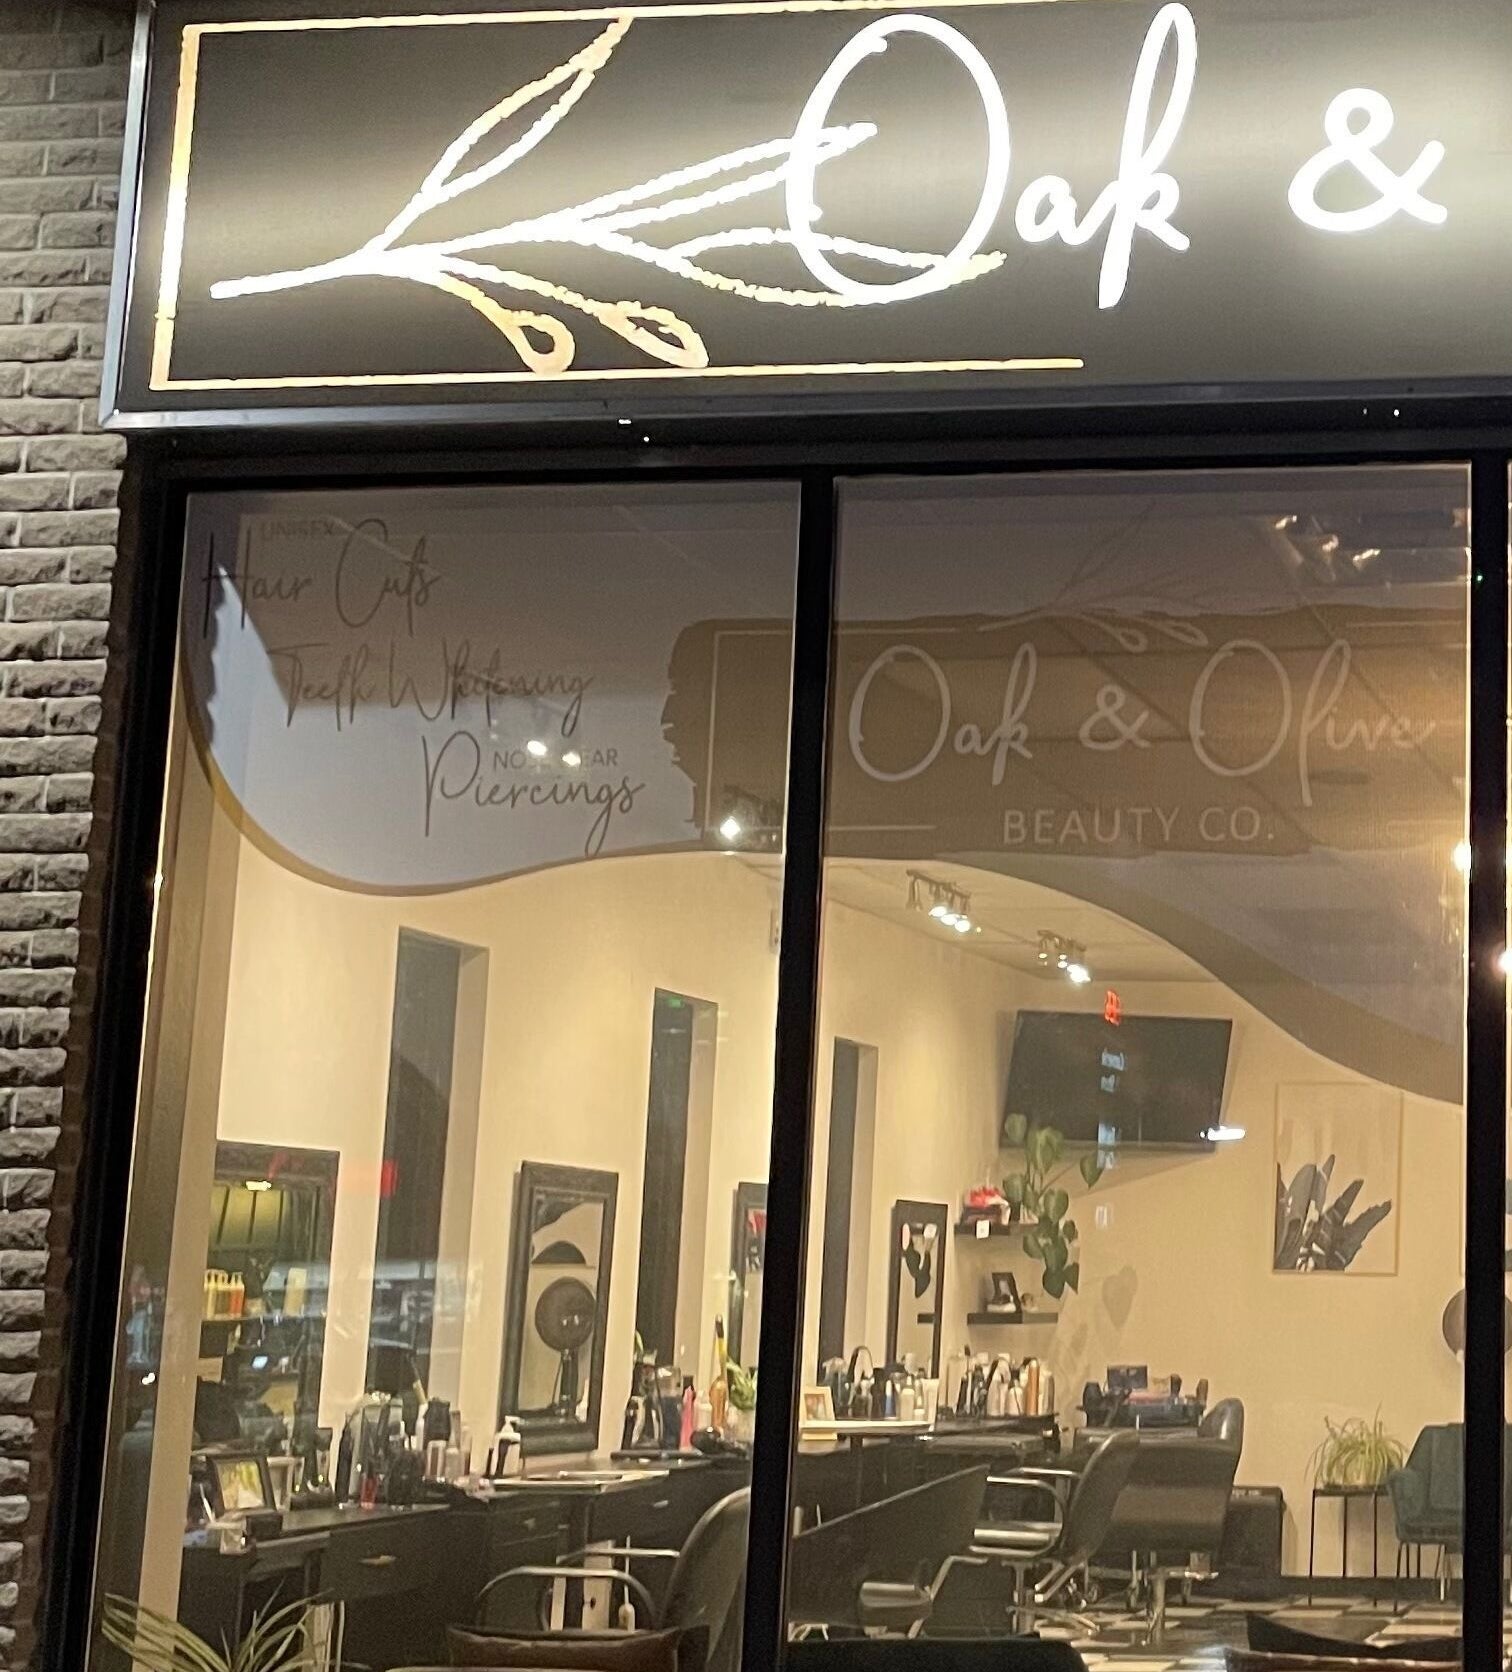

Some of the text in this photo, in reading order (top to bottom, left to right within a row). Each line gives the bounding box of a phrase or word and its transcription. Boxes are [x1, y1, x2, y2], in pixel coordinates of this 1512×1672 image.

[786, 2, 1190, 308] Oak
[1287, 87, 1448, 232] &
[202, 518, 441, 640] Hair Cuts
[267, 642, 375, 732] Teeth
[848, 639, 1436, 806] Oak & Olive
[421, 730, 647, 858] Piercings
[1003, 804, 1275, 846] BEAUTY CO.
